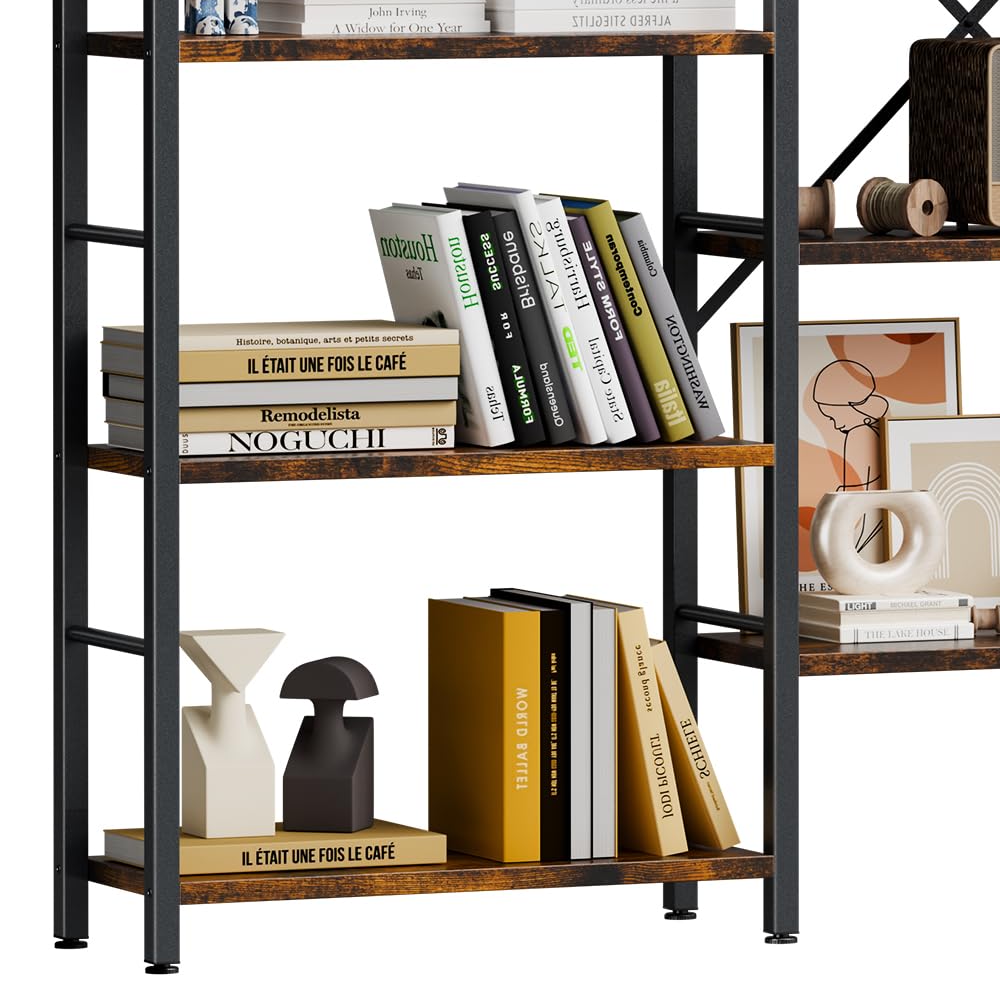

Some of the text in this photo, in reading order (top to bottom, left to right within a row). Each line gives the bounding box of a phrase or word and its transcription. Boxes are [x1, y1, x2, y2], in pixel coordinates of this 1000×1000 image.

[368, 6, 427, 20] John Irving
[332, 22, 462, 33] A Widow for One Year
[236, 338, 274, 346] Histoire,
[276, 337, 321, 345] botanique,
[355, 336, 380, 344] petits
[248, 352, 406, 374] IL ÉTAIT UNE FOIS LE CAFÉ
[261, 407, 360, 422] Remodelista
[228, 428, 385, 452] NOGUCHI
[800, 583, 815, 592] HE
[845, 602, 874, 610] LIGHT
[242, 842, 395, 866] IL ÉTAIT UNE FOIS LE CAFÉ
